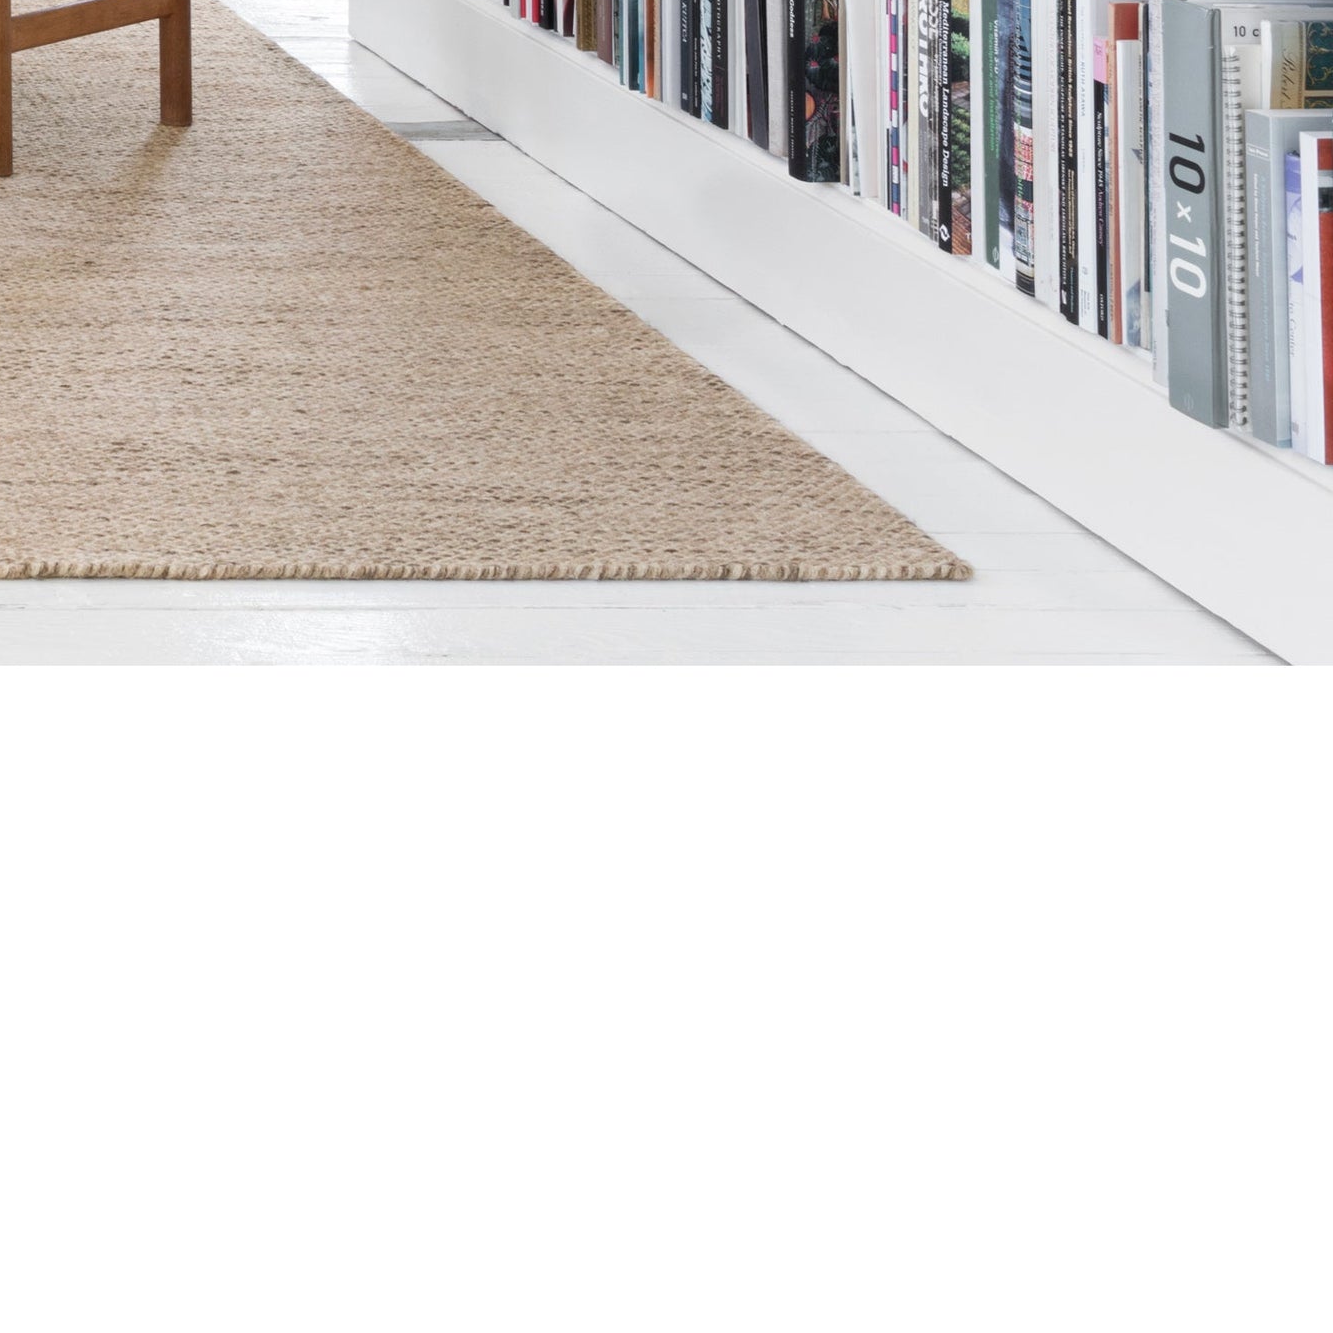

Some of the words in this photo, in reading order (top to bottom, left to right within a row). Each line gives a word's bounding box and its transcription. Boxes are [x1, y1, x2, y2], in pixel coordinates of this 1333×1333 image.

[788, 0, 796, 38] Goddess
[1233, 26, 1246, 37] 10
[942, 1, 950, 84] Mediterranean
[1282, 49, 1298, 100] Robert
[942, 87, 950, 147] Landscape
[941, 149, 950, 187] Design
[1168, 132, 1206, 195] 10
[1175, 201, 1192, 223] x
[1169, 233, 1207, 298] 10
[1289, 318, 1297, 358] Center
